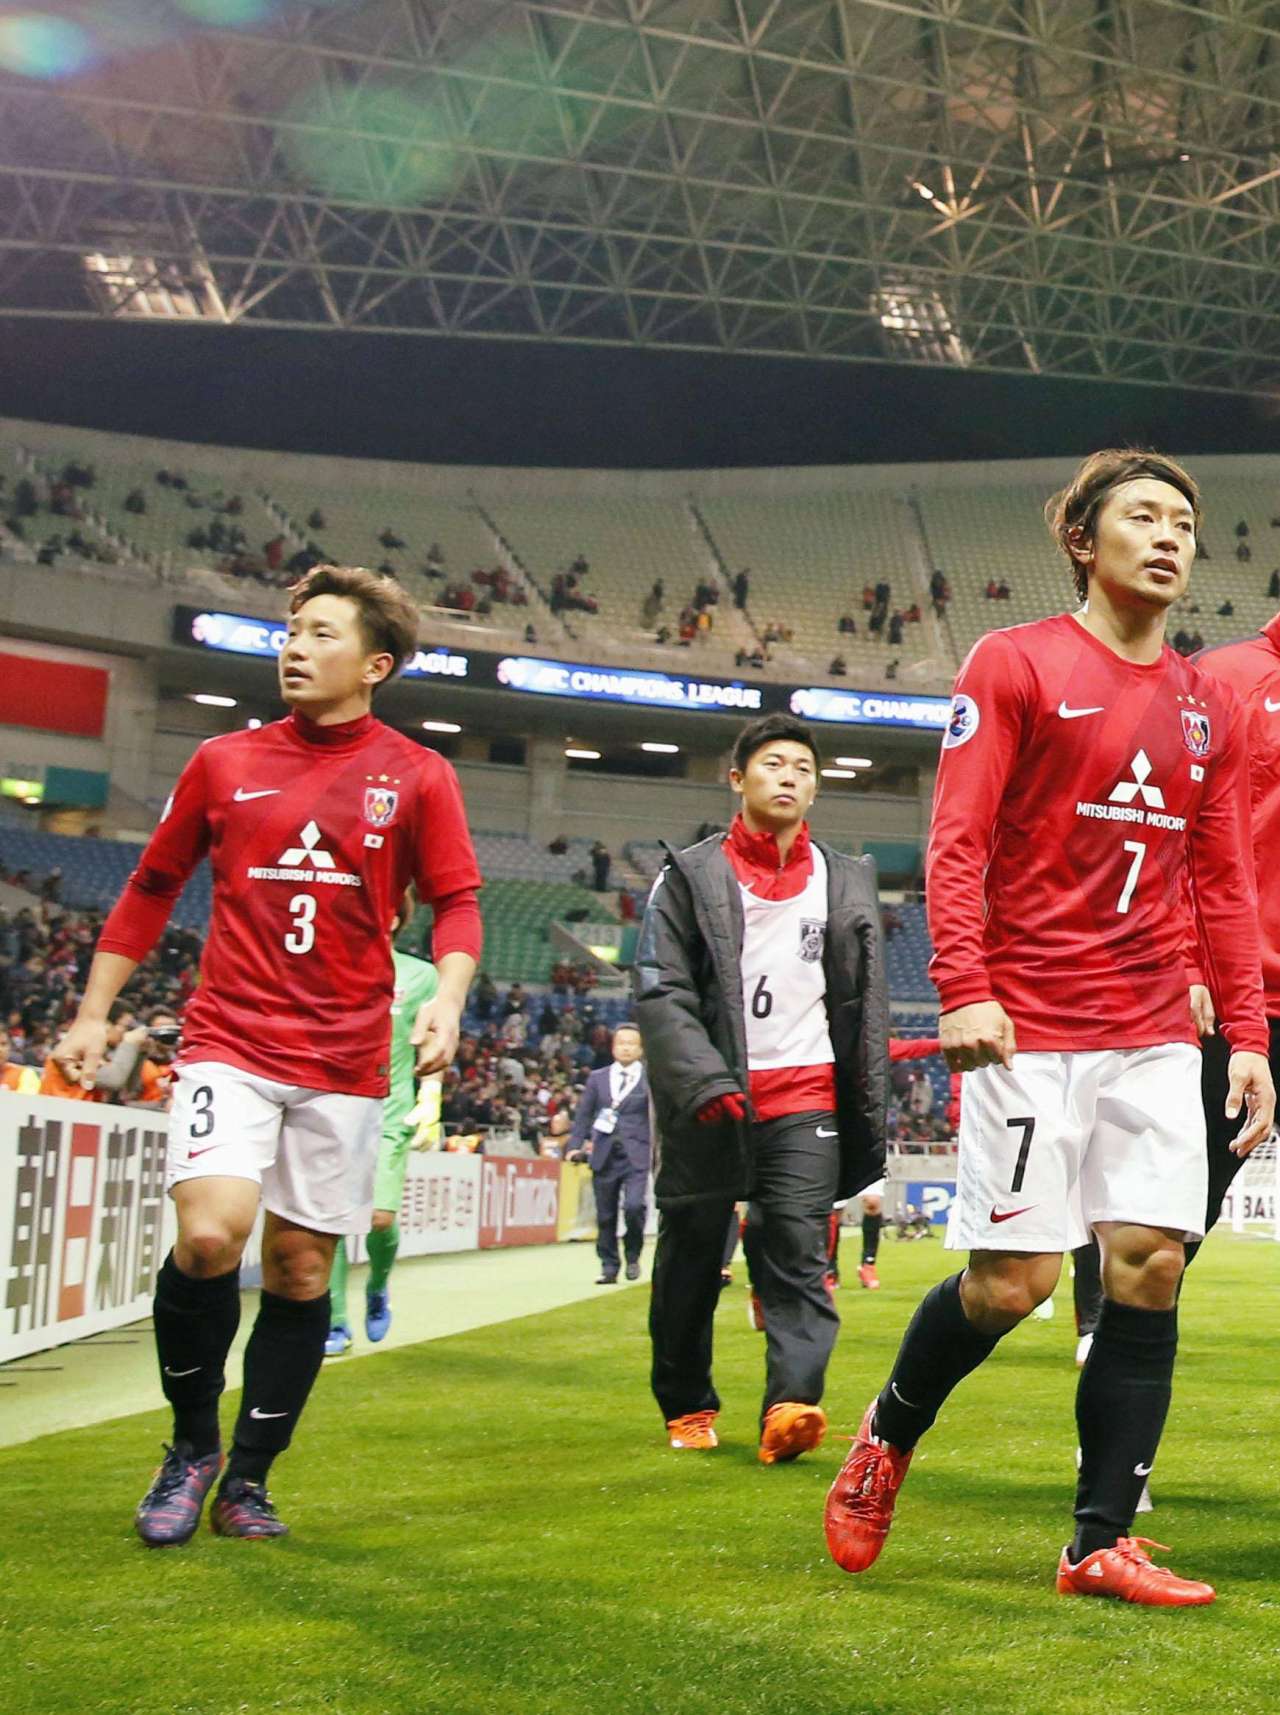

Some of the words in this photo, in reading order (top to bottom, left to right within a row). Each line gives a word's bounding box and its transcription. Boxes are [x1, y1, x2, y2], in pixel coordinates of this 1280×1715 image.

[406, 651, 468, 678] AGUE
[571, 672, 685, 701] CHAMPIONS
[688, 683, 762, 708] LEAGUE
[1077, 803, 1144, 822] MITSUBISHI
[248, 867, 313, 882] MITSUBISHI
[316, 871, 362, 887] MOTORS
[1116, 840, 1147, 914] 7
[284, 894, 317, 954] 3
[752, 975, 773, 1019] 6
[189, 1085, 215, 1138] 3
[1006, 1117, 1035, 1193] 7
[5, 1114, 168, 1335] 朝日新聞
